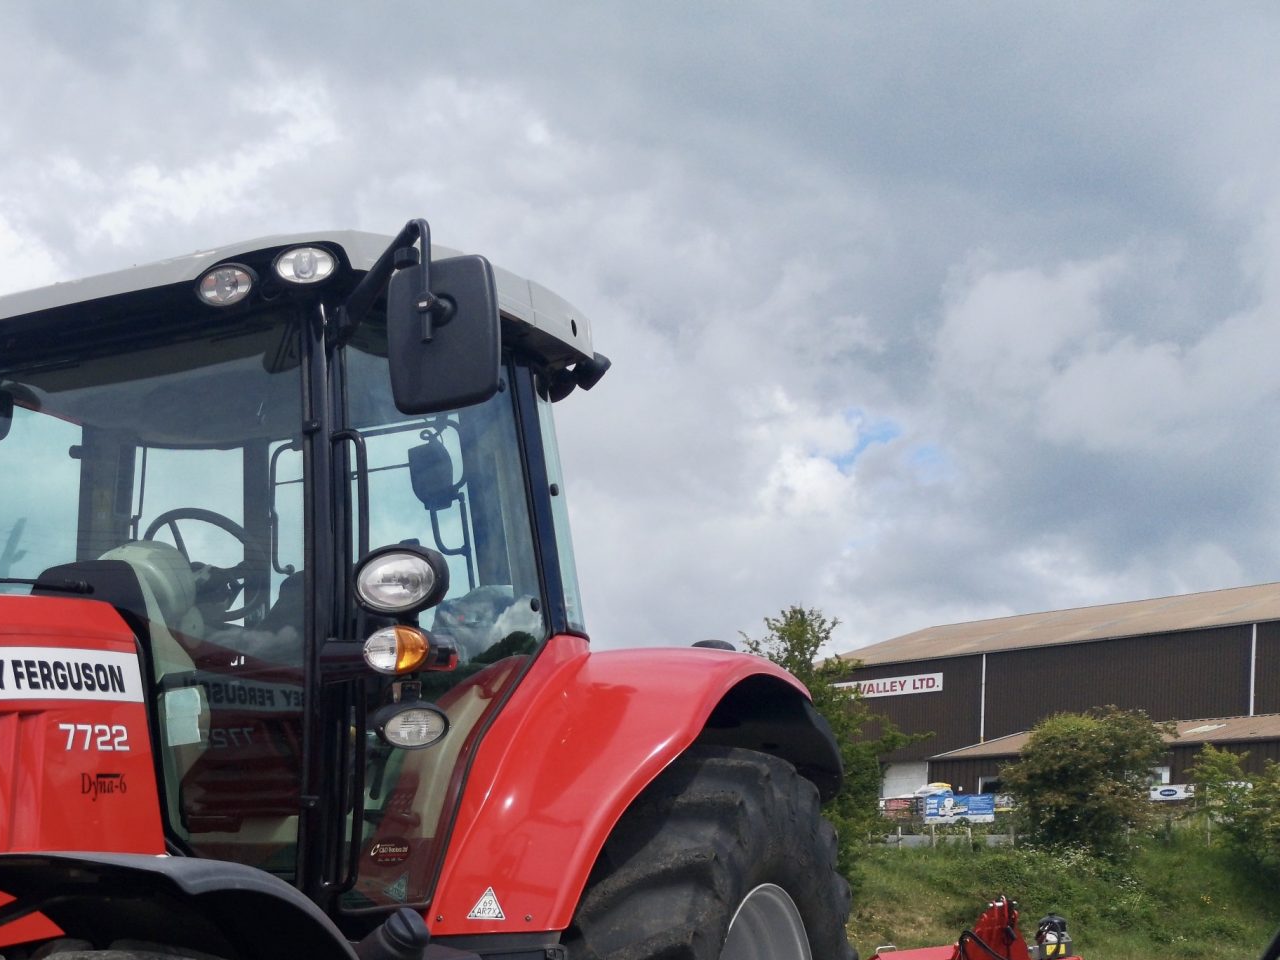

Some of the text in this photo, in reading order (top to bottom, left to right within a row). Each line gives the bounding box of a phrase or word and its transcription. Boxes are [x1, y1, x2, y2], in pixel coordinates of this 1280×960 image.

[11, 660, 126, 693] FERGUSON
[859, 680, 907, 695] VALLEY
[912, 677, 940, 690] LTD.
[59, 723, 130, 751] 7722
[81, 772, 127, 802] Dyna-6
[477, 907, 497, 915] AR7X
